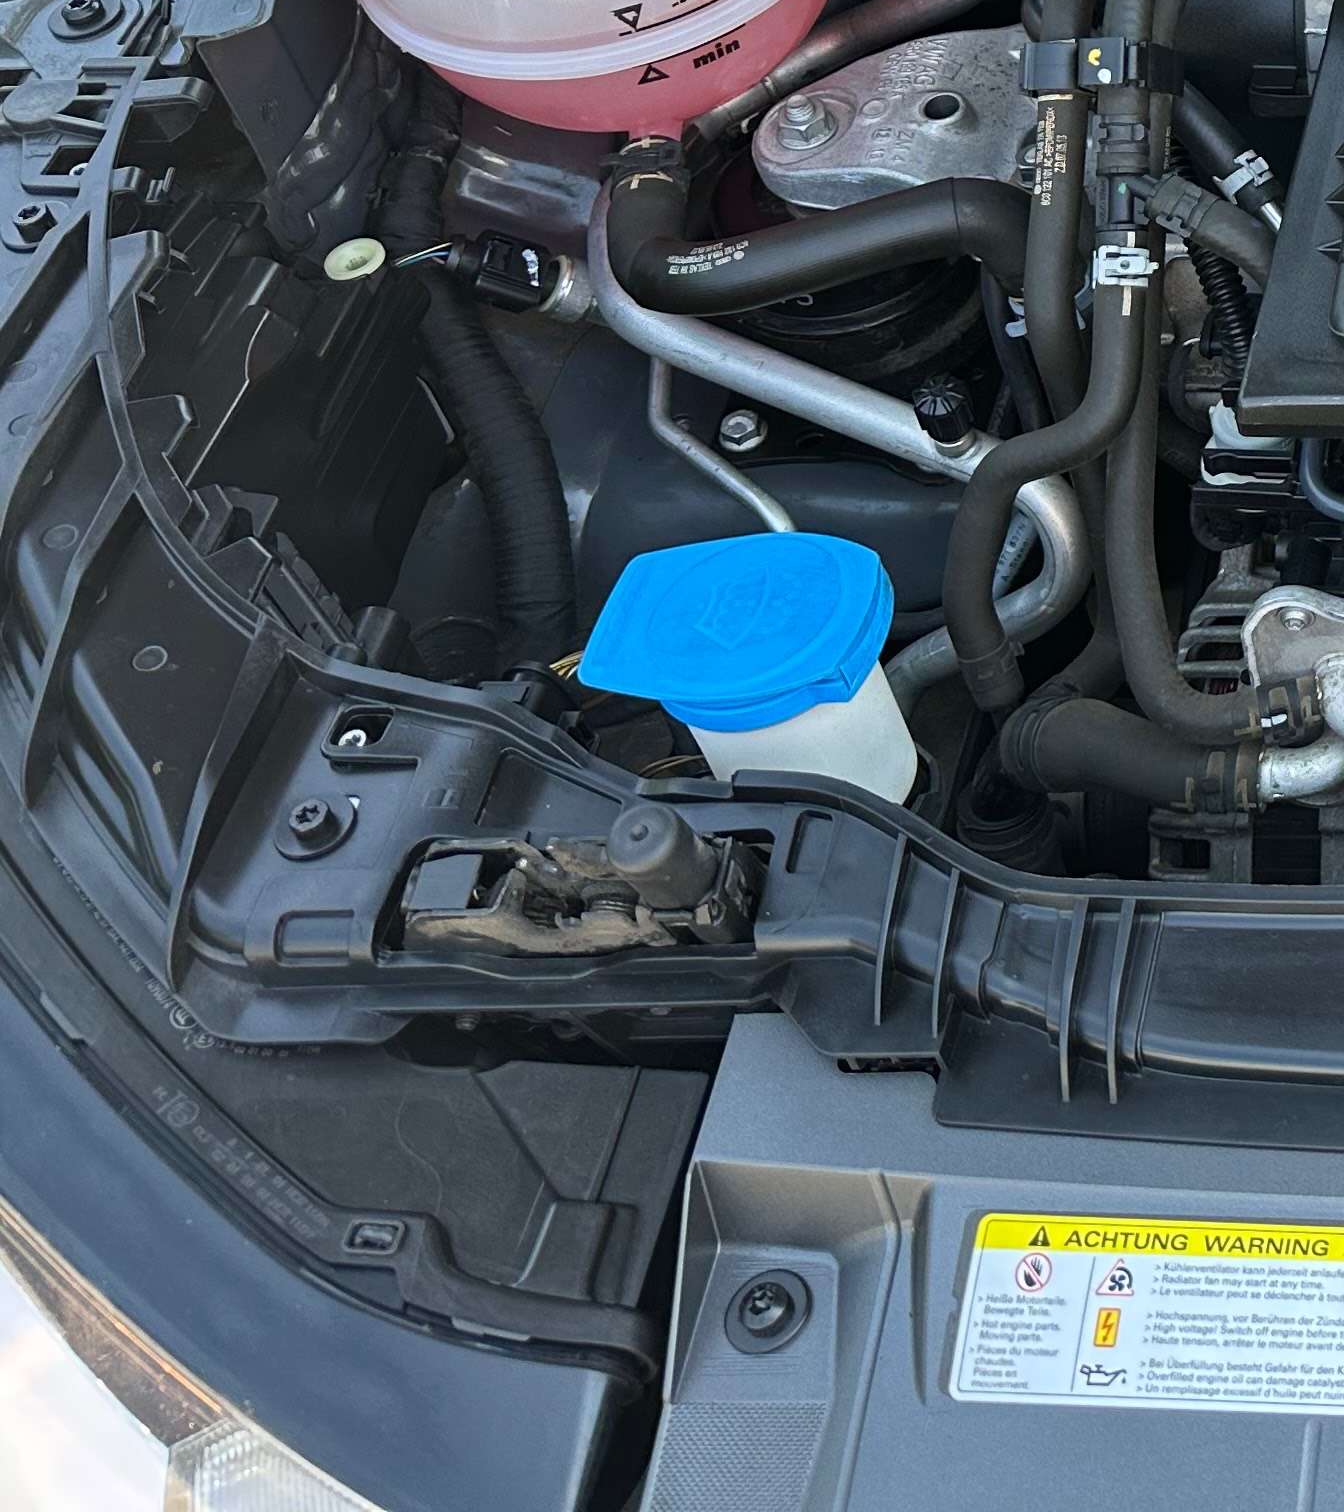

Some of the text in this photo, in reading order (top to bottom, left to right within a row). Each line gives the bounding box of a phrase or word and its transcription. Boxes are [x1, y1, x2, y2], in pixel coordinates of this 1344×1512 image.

[692, 40, 741, 69] min
[1063, 1229, 1189, 1251] ACHTUNG
[1202, 1235, 1330, 1256] WARNING
[1163, 1263, 1240, 1273] Kühlerventilator
[1241, 1267, 1266, 1275] kann
[1160, 1274, 1324, 1289] Radiator fan may start at any time.
[1158, 1286, 1171, 1296] Le
[1172, 1288, 1224, 1297] ventilateur
[1225, 1290, 1248, 1299] peut
[1250, 1291, 1261, 1299] se
[1263, 1291, 1316, 1301] déclencher
[1318, 1292, 1325, 1301] à
[1154, 1312, 1230, 1323] Hochspannung,
[1232, 1315, 1248, 1323] vor
[1250, 1314, 1296, 1324] Berühren
[1297, 1317, 1314, 1325] der
[1152, 1322, 1176, 1334] High
[1177, 1325, 1217, 1335] voltage!
[1219, 1324, 1253, 1335] Switch
[1254, 1326, 1269, 1336] off
[1270, 1329, 1304, 1338] engine
[1305, 1329, 1338, 1338] before
[1150, 1335, 1180, 1345] Haute
[1180, 1337, 1220, 1346] tension,
[1256, 1339, 1267, 1348] le
[1267, 1341, 1303, 1349] moteur
[1305, 1342, 1333, 1350] avant
[1148, 1358, 1165, 1368] Bei
[1226, 1362, 1262, 1372] besteht
[1264, 1362, 1298, 1373] Gefahr
[1299, 1364, 1314, 1374] für
[1316, 1366, 1335, 1374] den
[1146, 1370, 1194, 1382] Overfilled
[1195, 1375, 1229, 1384] engine
[1231, 1374, 1244, 1384] oil
[1245, 1376, 1263, 1384] can
[1264, 1377, 1305, 1387] damage
[1144, 1383, 1160, 1393] Un
[1161, 1386, 1221, 1396] remplissage
[1222, 1387, 1262, 1396] excessif
[1263, 1388, 1297, 1398] d'huile
[1298, 1390, 1321, 1399] peut
